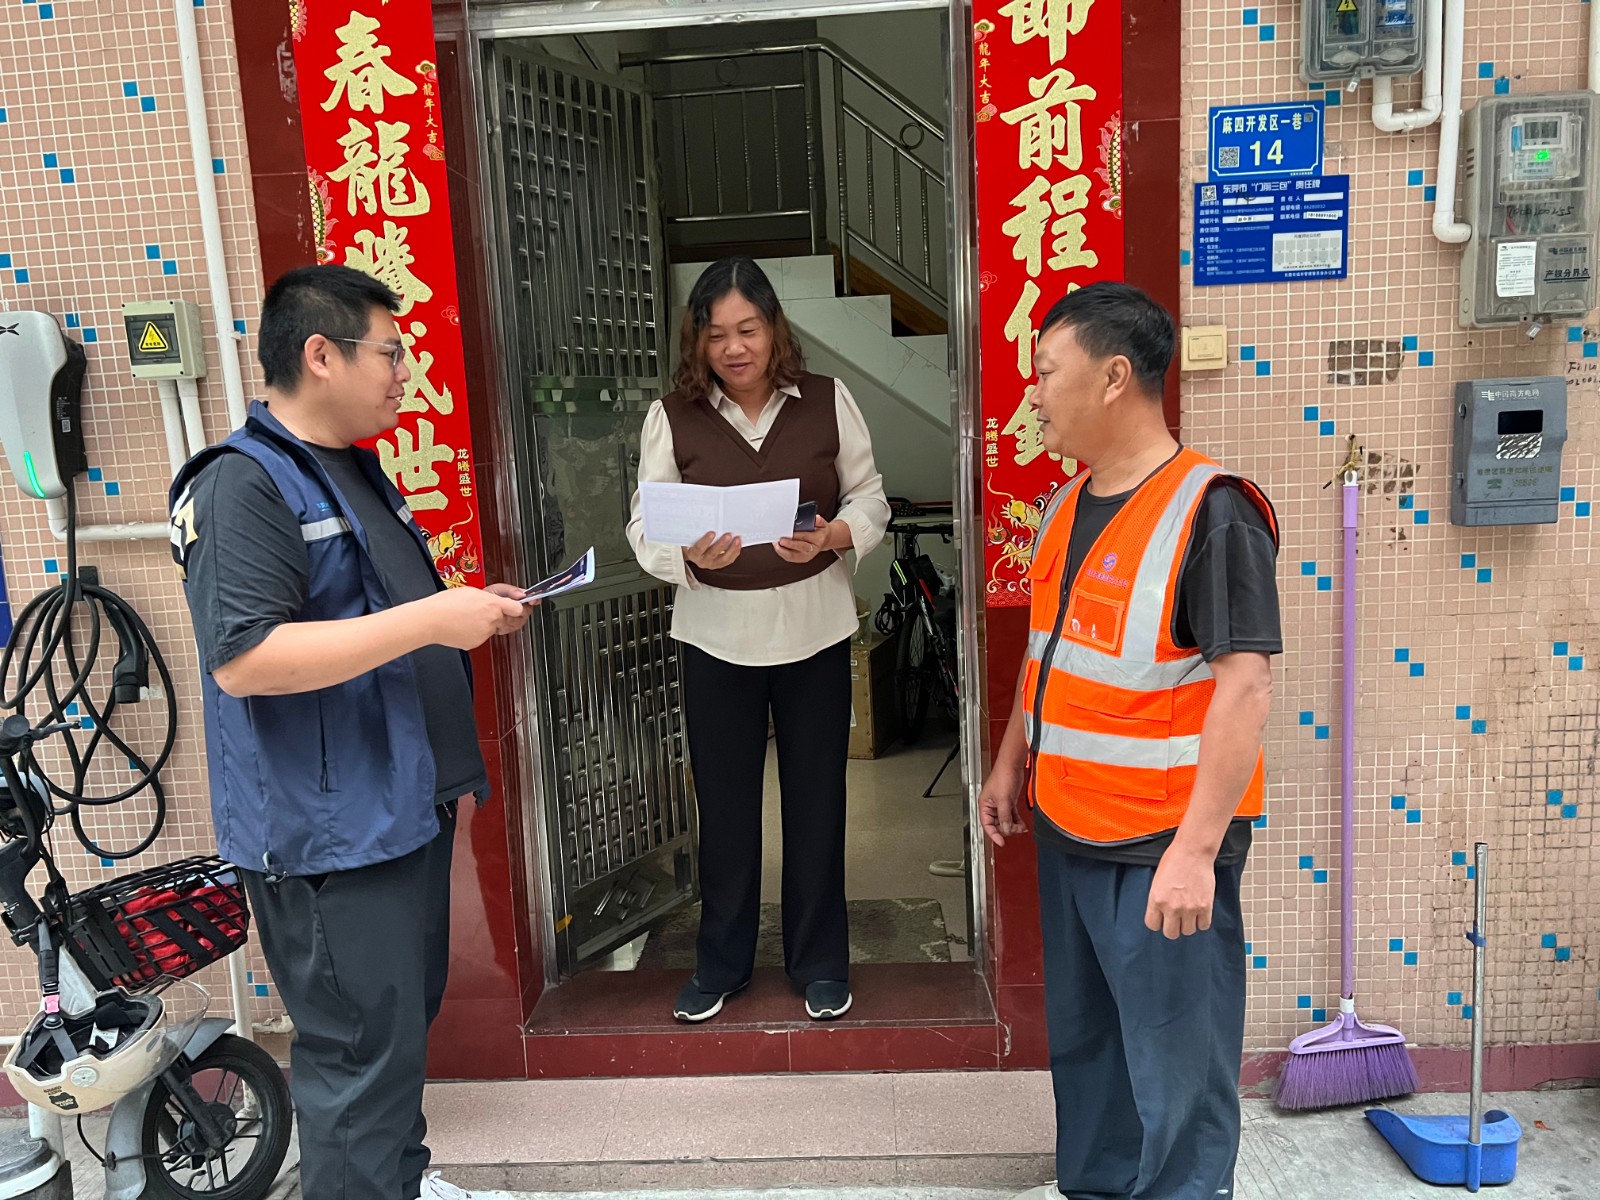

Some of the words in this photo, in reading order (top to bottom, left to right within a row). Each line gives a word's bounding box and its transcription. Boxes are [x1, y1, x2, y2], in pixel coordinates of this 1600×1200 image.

[1222, 112, 1302, 134] 麻四开发区一巷
[1249, 139, 1284, 166] 14
[1545, 267, 1590, 279] 产权分界点
[1494, 388, 1540, 398] 中国南方电网
